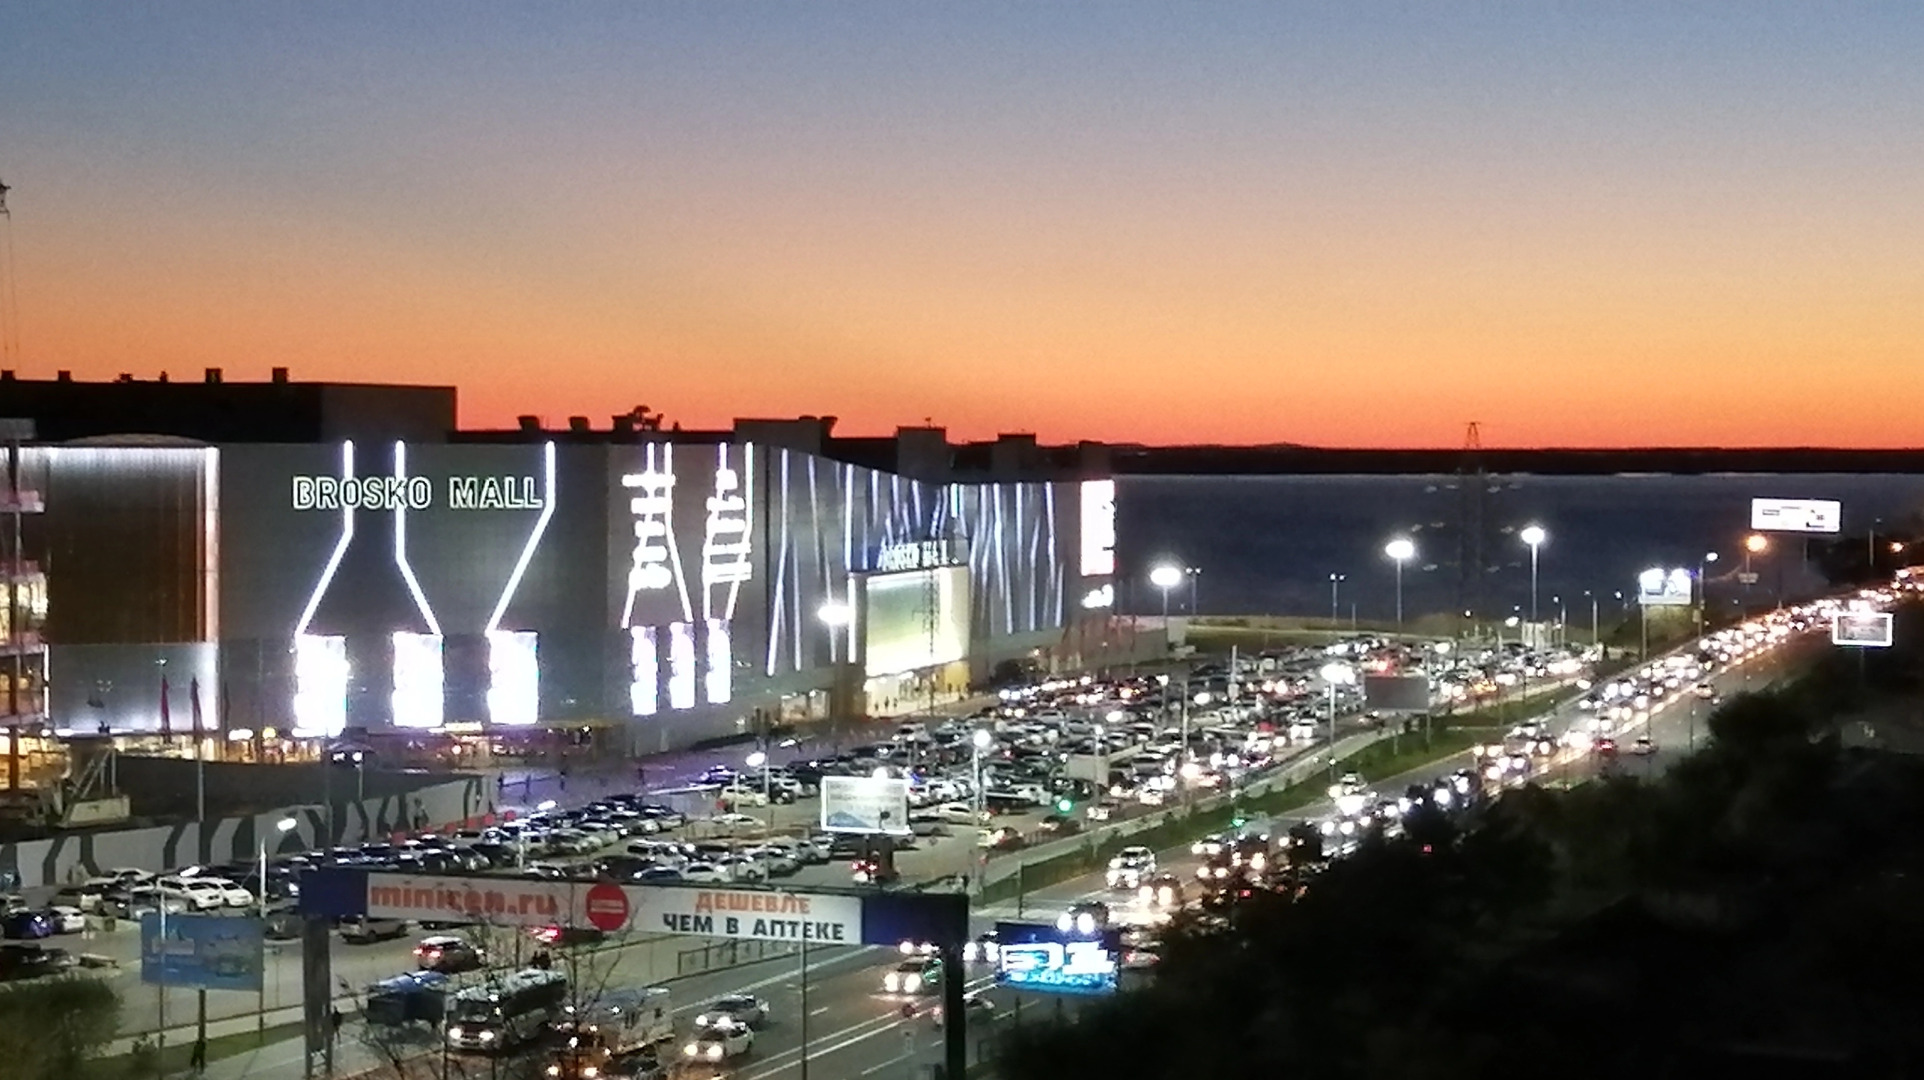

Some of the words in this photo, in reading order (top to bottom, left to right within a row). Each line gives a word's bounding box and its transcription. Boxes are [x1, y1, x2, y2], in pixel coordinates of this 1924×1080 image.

[292, 476, 432, 510] BROSKO
[449, 476, 543, 509] MALL
[695, 892, 812, 915] ДЕШЕВЛЕ
[663, 913, 713, 934] ЧЕМ
[726, 917, 739, 934] В
[753, 918, 844, 941] АПТЕКЕ
